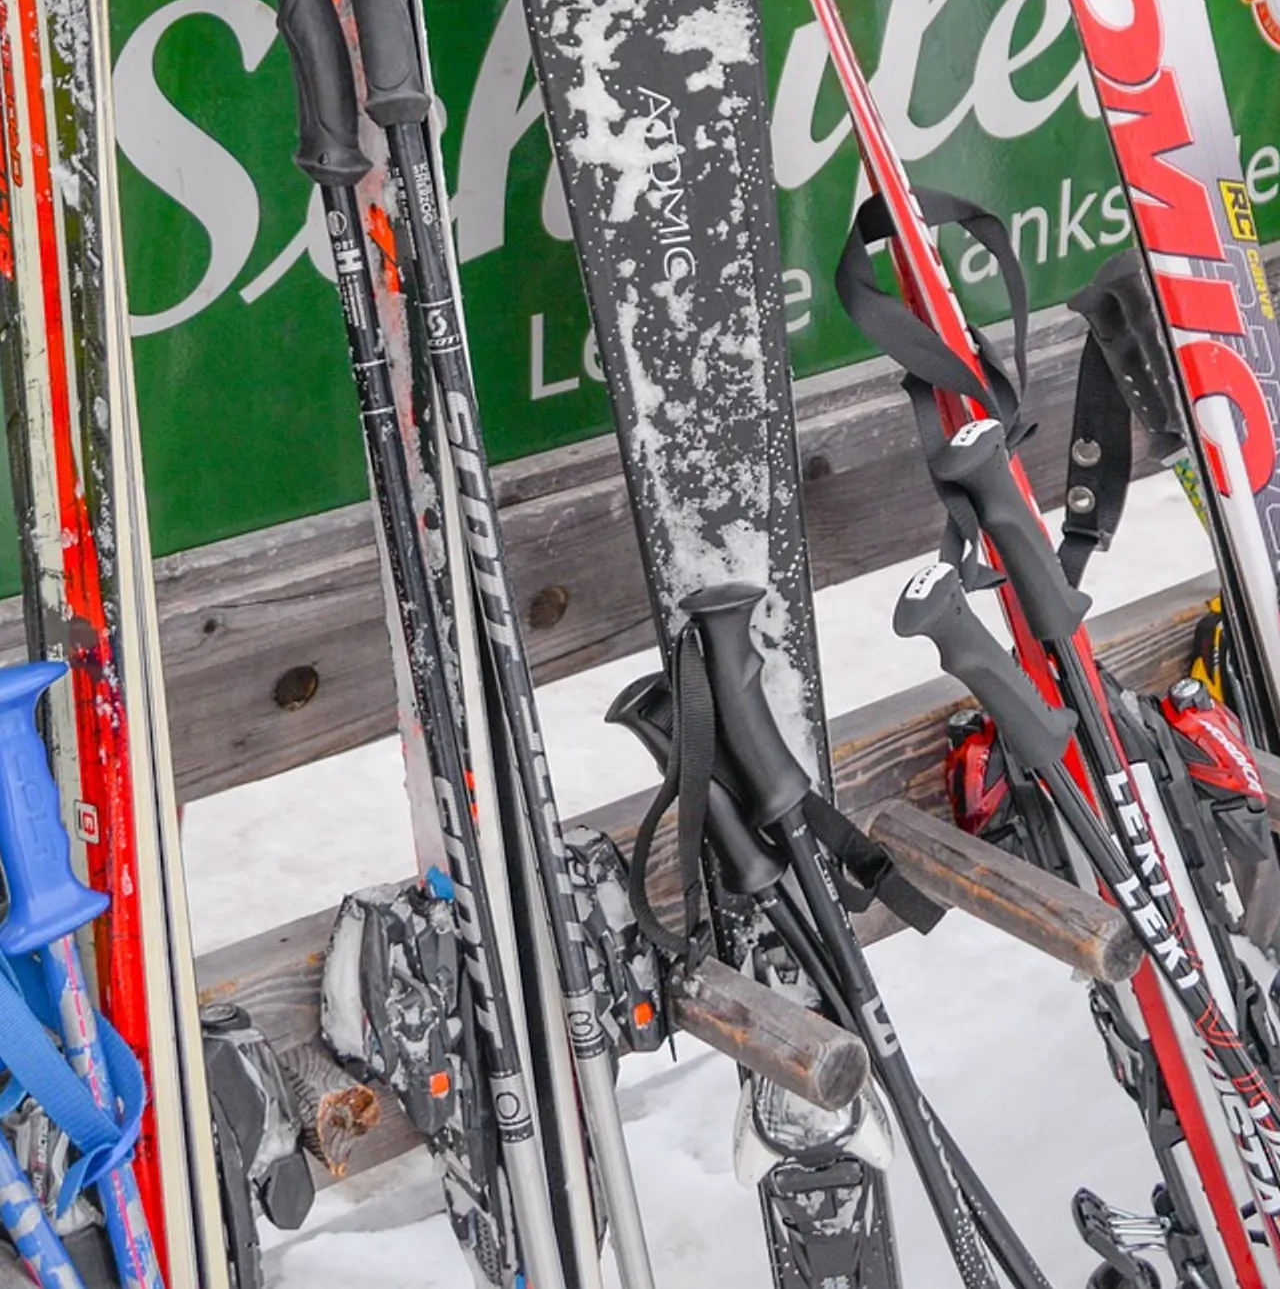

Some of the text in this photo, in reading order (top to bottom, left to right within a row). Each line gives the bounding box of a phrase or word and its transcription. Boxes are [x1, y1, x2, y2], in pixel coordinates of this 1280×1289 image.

[637, 85, 696, 276] ATOMIC
[1221, 180, 1257, 240] RC
[447, 390, 520, 661] SCOTT
[433, 775, 503, 1050] SCOTT
[1105, 772, 1171, 900] LEKI
[1113, 874, 1201, 990] LEKI
